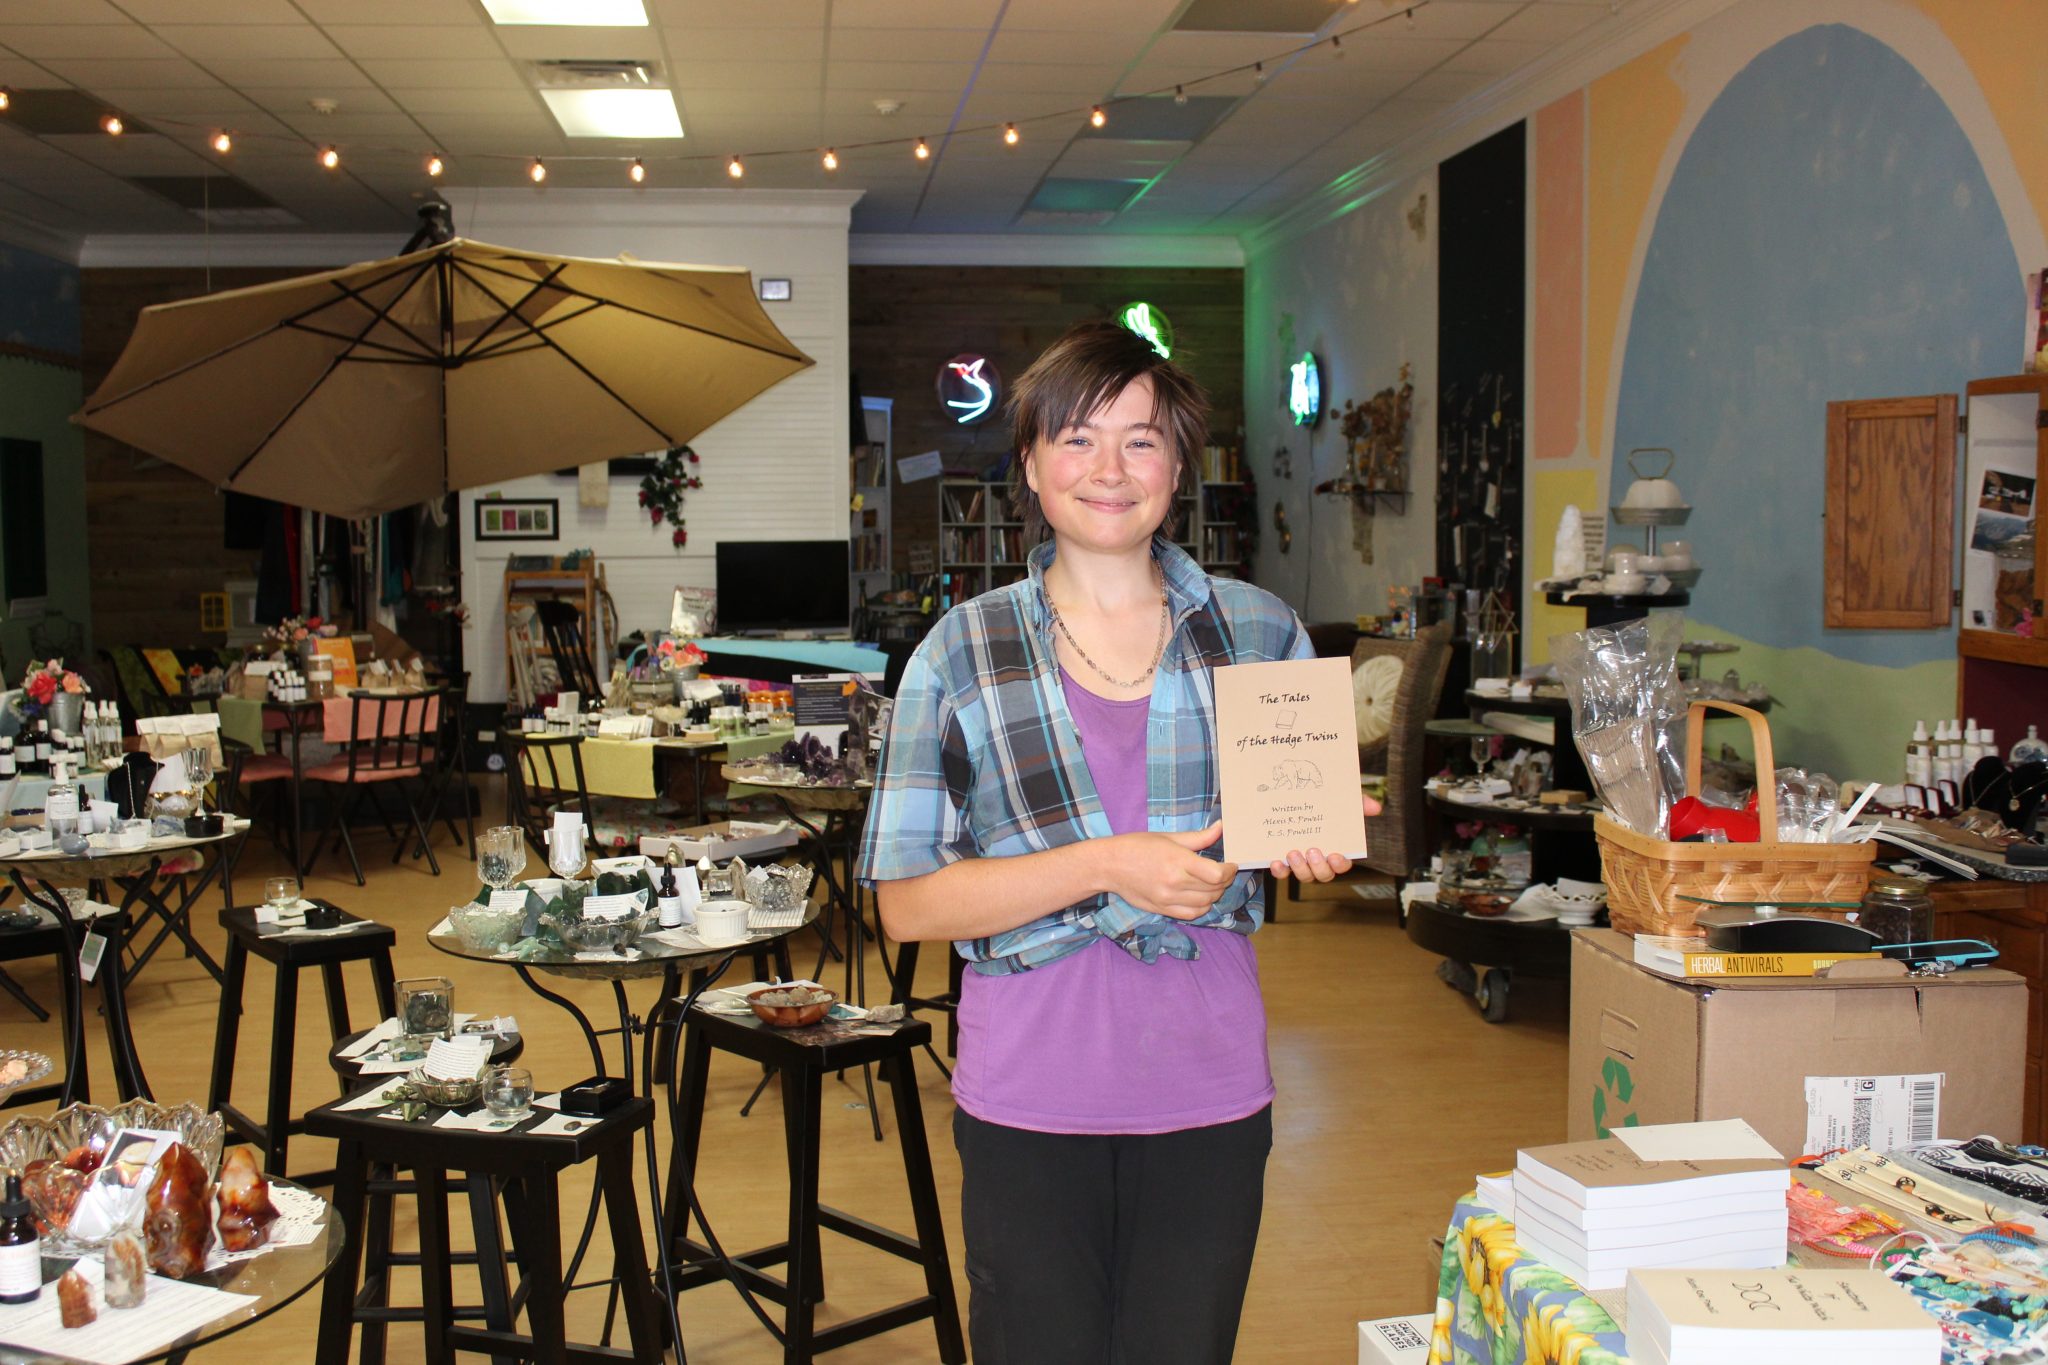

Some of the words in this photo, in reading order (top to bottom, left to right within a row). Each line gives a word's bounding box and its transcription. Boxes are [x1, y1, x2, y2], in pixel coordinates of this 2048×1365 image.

[1258, 693, 1279, 705] The
[1282, 691, 1310, 703] Tales
[1236, 736, 1248, 752] of
[1250, 735, 1268, 746] the
[1270, 734, 1302, 749] Hedge
[1304, 731, 1338, 743] Twins
[1303, 802, 1314, 813] by
[1262, 817, 1286, 825] Alexis
[1297, 814, 1323, 824] Powell
[1287, 826, 1313, 837] Powell
[1691, 956, 1726, 974] HERBAL
[1726, 956, 1784, 974] ANTIVIRALS
[1863, 1081, 1873, 1090] G
[1380, 1324, 1408, 1349] BLADES
